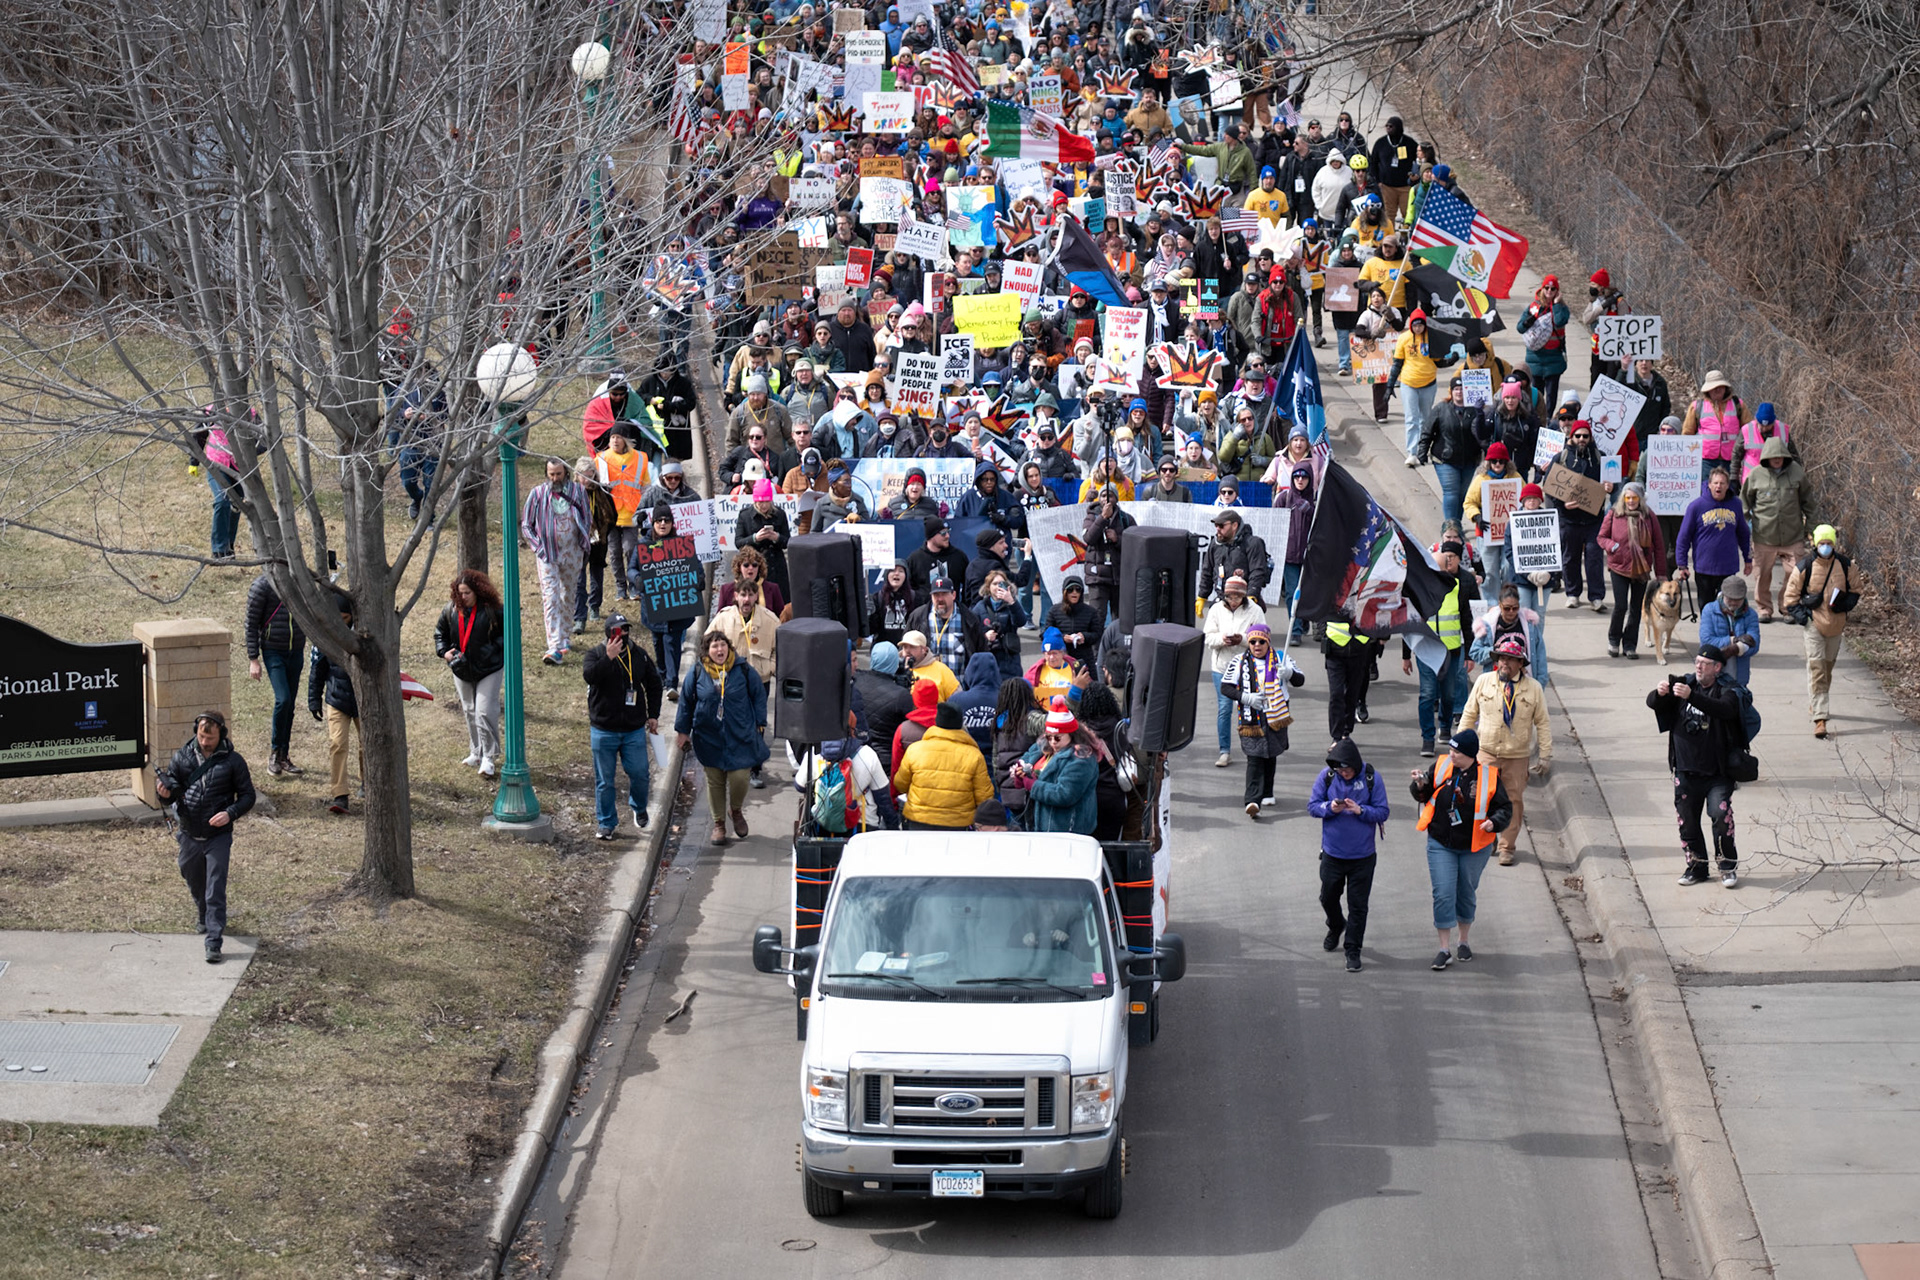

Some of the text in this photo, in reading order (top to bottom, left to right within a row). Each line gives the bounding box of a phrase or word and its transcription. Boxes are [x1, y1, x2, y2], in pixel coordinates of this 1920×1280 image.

[846, 49, 885, 57] PRO-AMERICA
[1031, 79, 1059, 88] NO
[1031, 87, 1060, 98] KINGS
[1032, 97, 1059, 106] NO
[873, 117, 908, 130] BRAVE
[1106, 172, 1135, 184] JUSTICE
[1120, 186, 1135, 195] GOOD
[877, 205, 894, 213] SEX
[904, 227, 940, 241] HATE
[756, 250, 795, 265] NICE
[848, 262, 864, 273] NOT
[1014, 266, 1033, 277] HAD
[847, 271, 866, 281] WAR
[1003, 280, 1039, 294] ENOUGH
[966, 300, 1012, 314] Defend
[1108, 309, 1144, 319] DONALD
[1110, 316, 1141, 325] TRUMP
[958, 318, 1003, 329] Democracy
[1603, 318, 1655, 336] STOP
[944, 338, 971, 351] ICE
[1602, 335, 1659, 357] GRIFT
[906, 358, 937, 370] DO YOU
[901, 368, 939, 380] HEAR THE
[944, 369, 970, 379] OUT!
[901, 378, 933, 390] PEOPLE
[897, 388, 934, 404] SING?
[1599, 378, 1641, 404] DOES THIS
[1540, 430, 1548, 438] NO
[1588, 416, 1617, 440] ASS
[1538, 440, 1547, 449] NO
[1653, 440, 1684, 452] WHEN
[1650, 454, 1699, 467] INJUSTICE
[929, 473, 974, 486] WE'LL BE
[1681, 471, 1698, 480] LAW
[1492, 489, 1517, 501] HAVE
[679, 503, 704, 517] WILL
[719, 500, 739, 513] The
[1492, 503, 1518, 518] HAD
[1658, 500, 1684, 511] DUTY
[1514, 515, 1555, 528] SOLIDARITY
[1520, 527, 1551, 540] WITH OUR
[637, 533, 697, 563] BOMBS
[1516, 543, 1557, 556] IMMIGRANT
[641, 557, 687, 572] CANNOT
[1518, 555, 1557, 567] NEIGHBORS
[655, 563, 691, 577] DESTROY
[643, 571, 699, 595] EPSTIEN
[650, 587, 699, 612] FILES
[65, 668, 120, 692] Park
[965, 706, 978, 717] IT'S
[10, 734, 116, 750] GREAT RIVER PASSAGE
[1, 743, 118, 761] PARKS AND RECREATION
[947, 1098, 969, 1109] Ford
